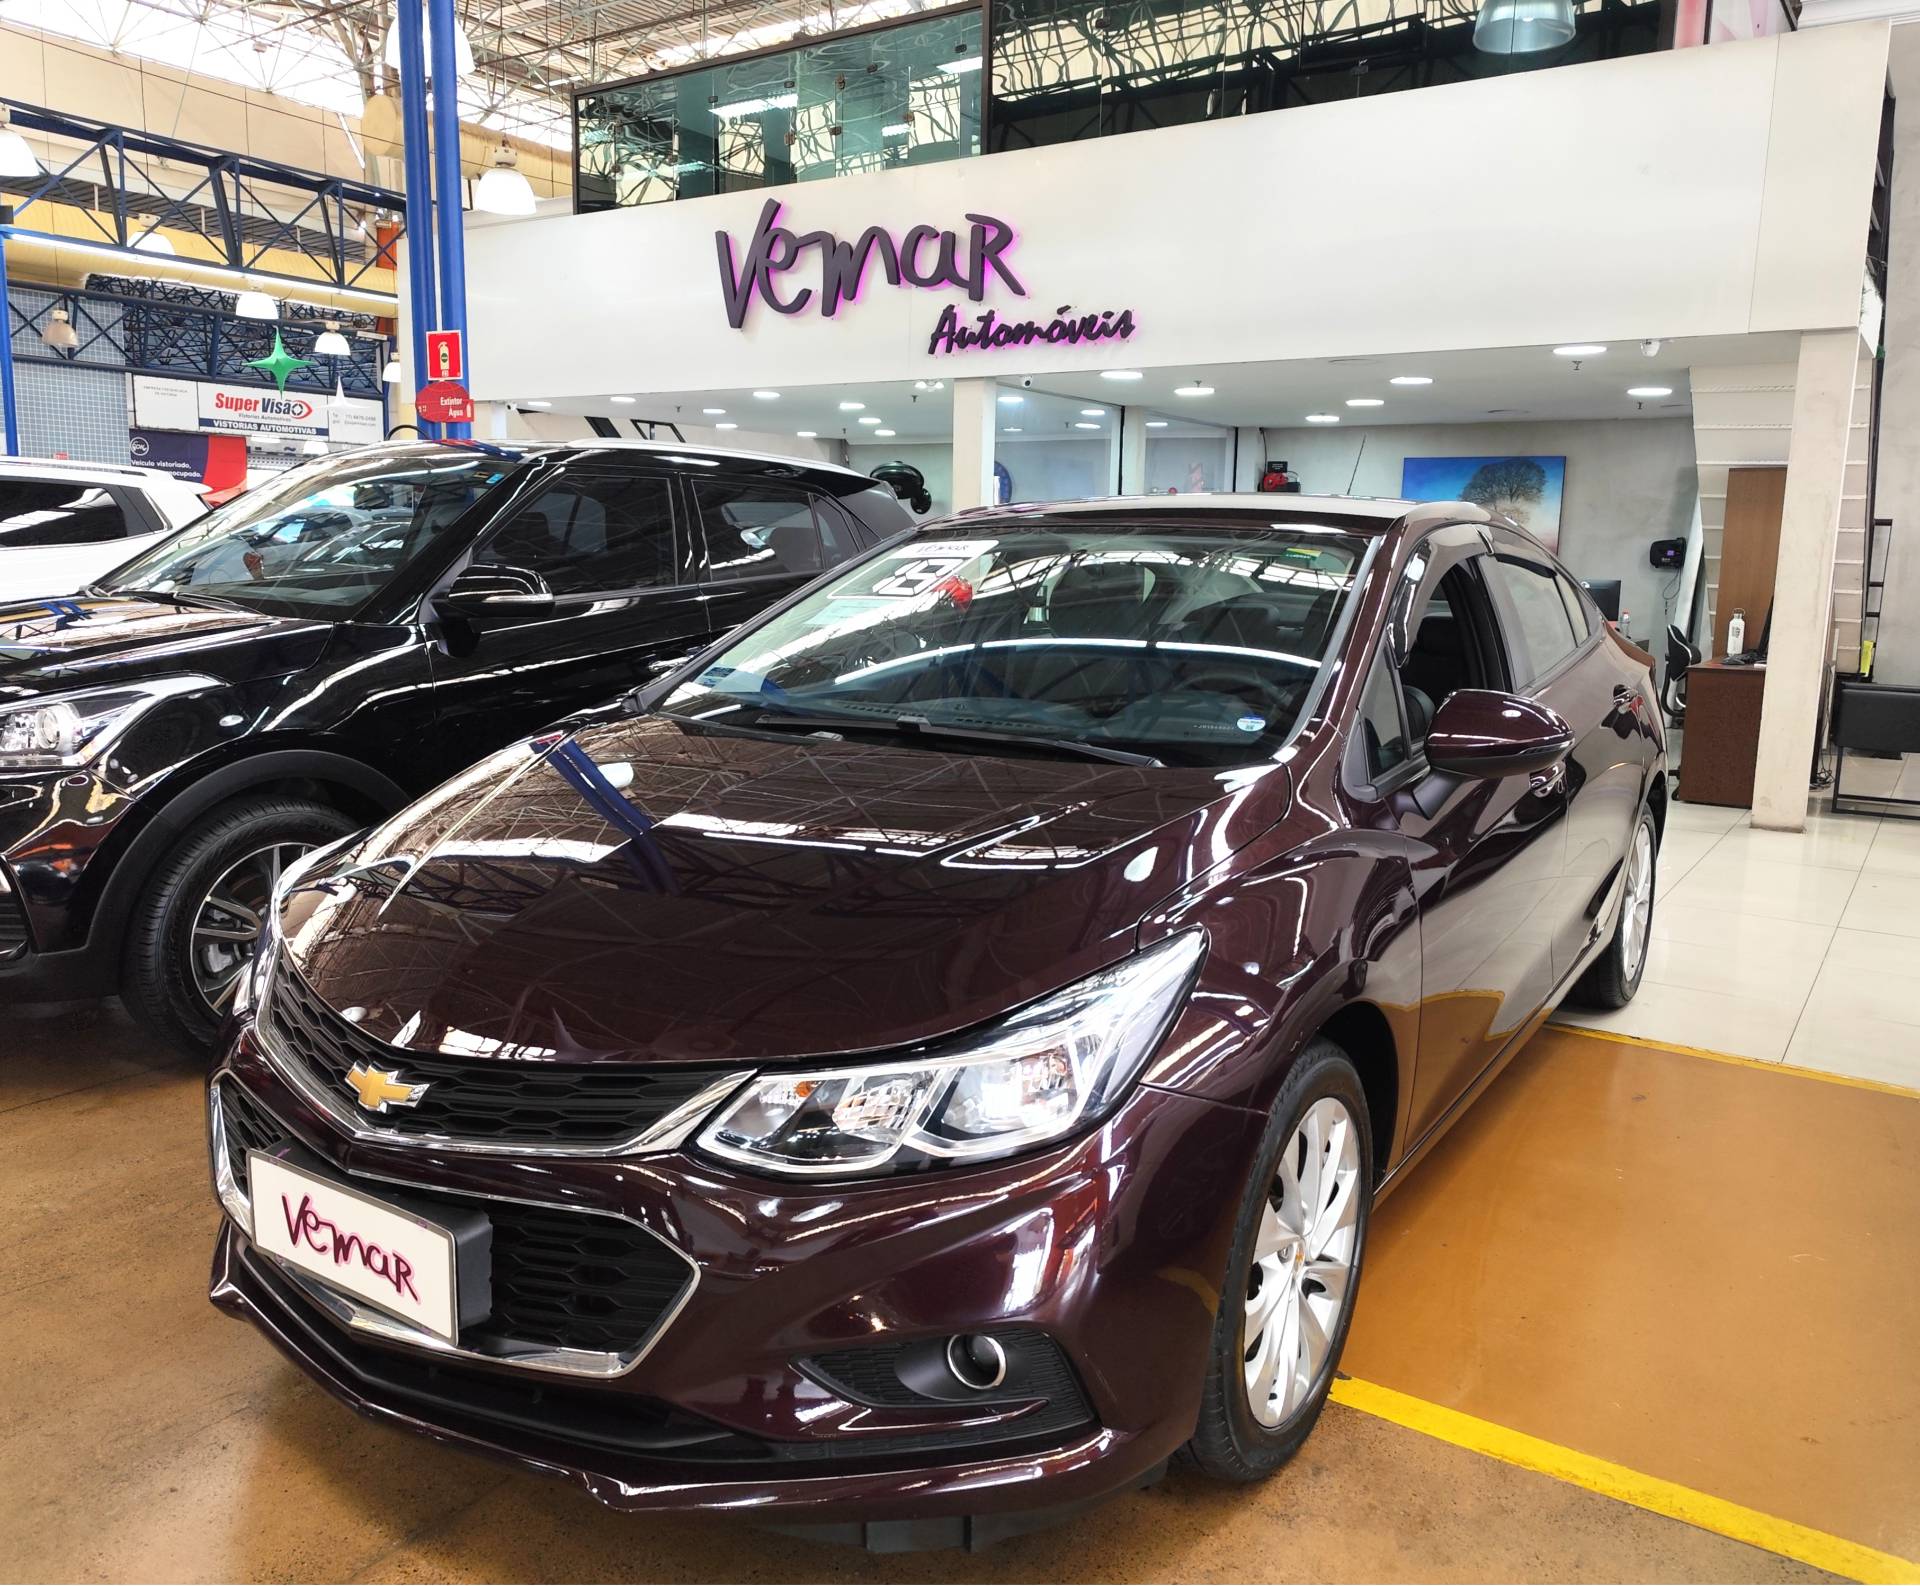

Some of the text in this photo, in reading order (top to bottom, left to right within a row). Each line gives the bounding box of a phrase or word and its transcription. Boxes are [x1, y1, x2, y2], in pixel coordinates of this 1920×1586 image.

[928, 304, 1136, 355] Automóveis
[440, 396, 463, 406] Extintor
[448, 406, 464, 417] Água
[259, 424, 317, 435] AUTOMOTIVAS
